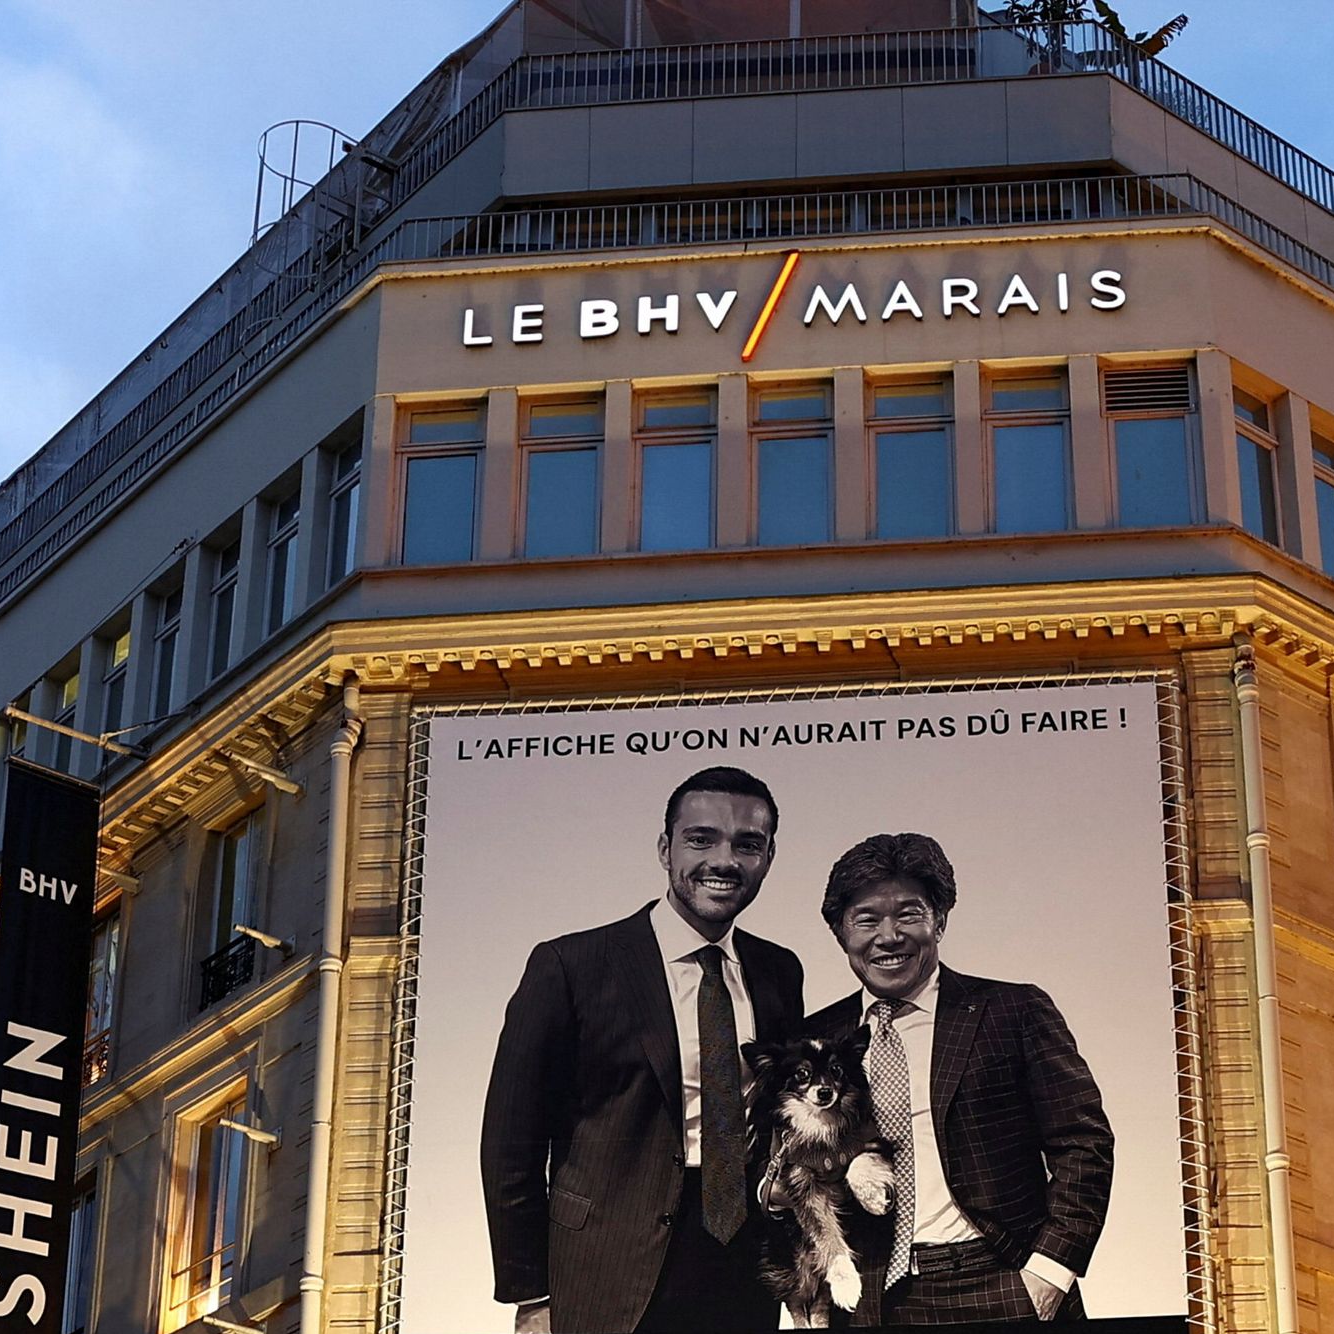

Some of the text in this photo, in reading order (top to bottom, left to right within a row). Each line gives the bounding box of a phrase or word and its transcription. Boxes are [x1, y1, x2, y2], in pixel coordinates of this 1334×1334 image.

[463, 304, 544, 346] LE
[898, 716, 956, 740] PAS
[968, 708, 1010, 735] DÛ
[1021, 709, 1108, 734] FAIRE
[19, 867, 78, 905] BHV
